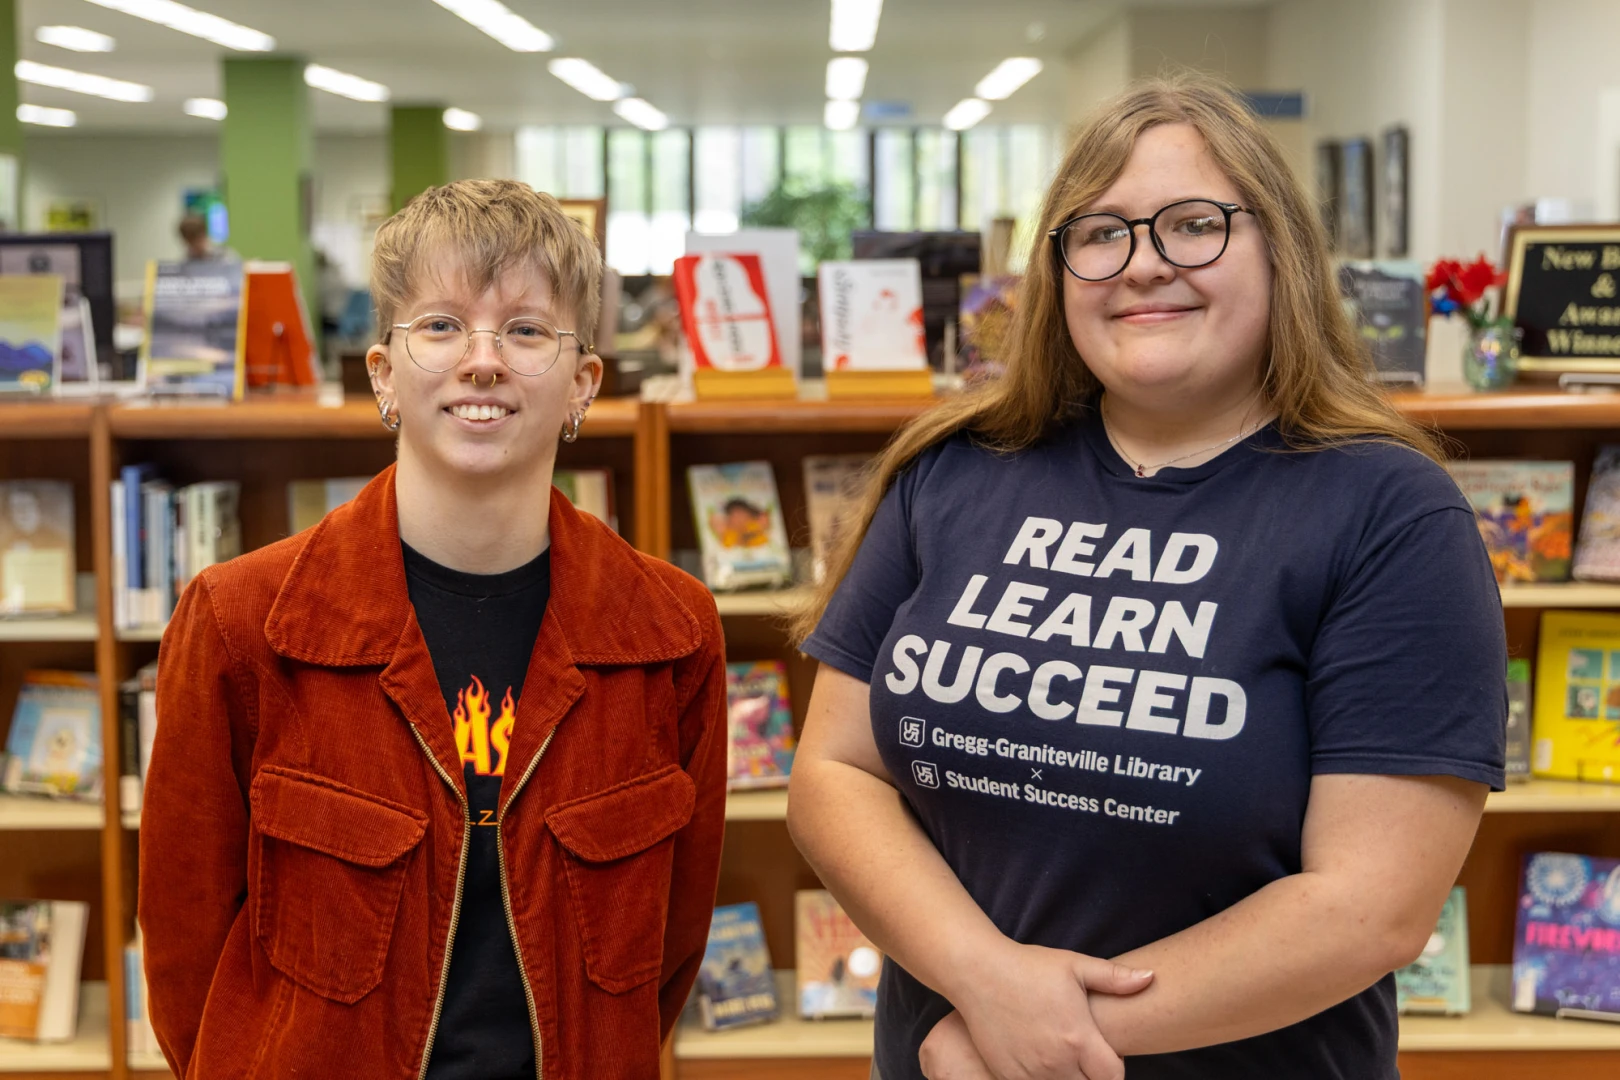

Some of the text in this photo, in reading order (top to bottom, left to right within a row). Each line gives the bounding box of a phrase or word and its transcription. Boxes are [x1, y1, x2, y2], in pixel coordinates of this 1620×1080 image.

[1542, 245, 1597, 271] New
[1590, 272, 1617, 298] &
[1003, 516, 1219, 585] READ
[947, 574, 1219, 660] LEARN
[884, 633, 1248, 741] SUCCEED
[932, 727, 1109, 773] Gregg-Graniteville
[1113, 754, 1202, 786] Library
[945, 770, 1020, 800] Student
[1023, 783, 1100, 813] Success
[1104, 798, 1180, 825] Center
